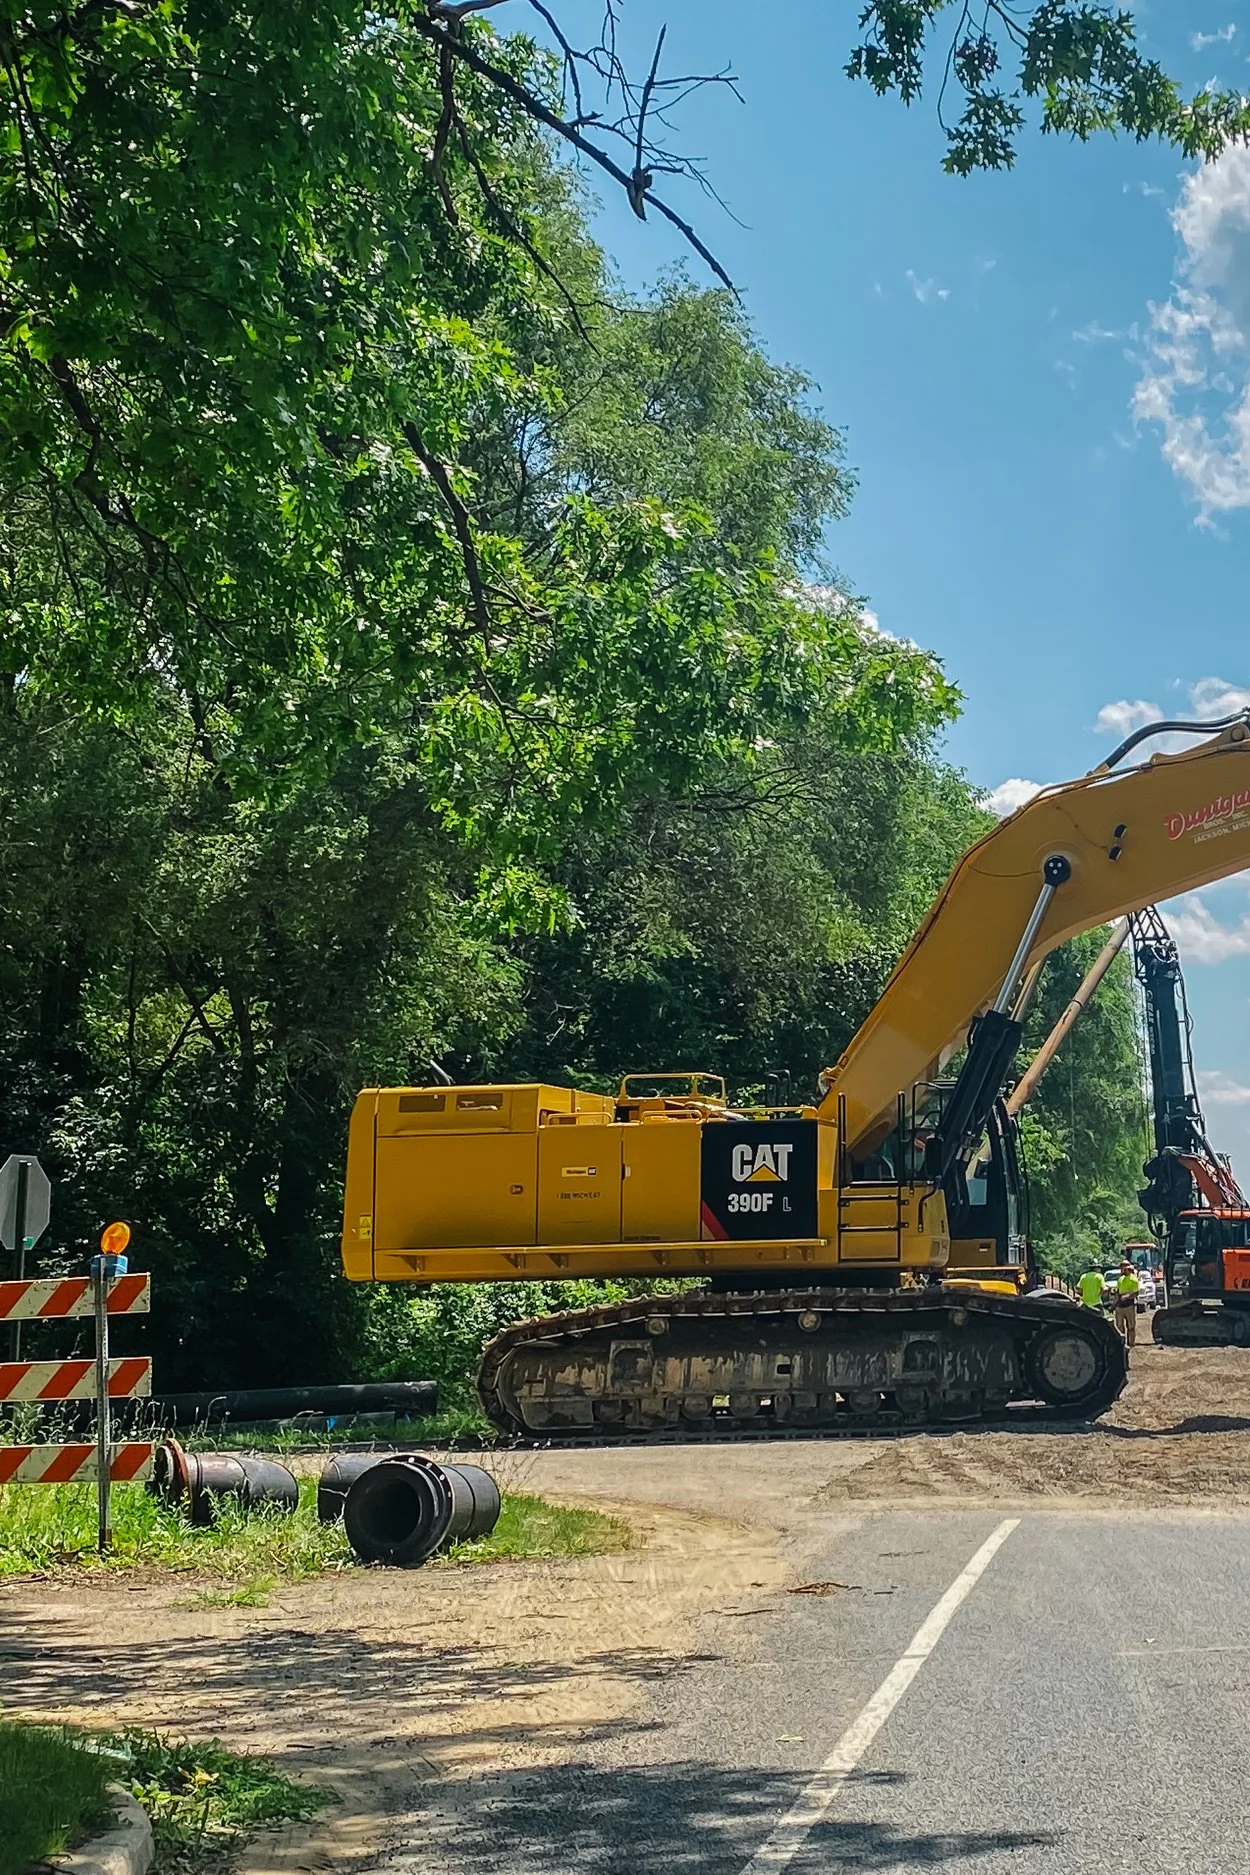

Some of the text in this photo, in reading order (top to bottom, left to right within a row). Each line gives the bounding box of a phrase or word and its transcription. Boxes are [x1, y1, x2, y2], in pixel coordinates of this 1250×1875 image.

[732, 1144, 793, 1182] CAT
[727, 1193, 792, 1213] 390F L
